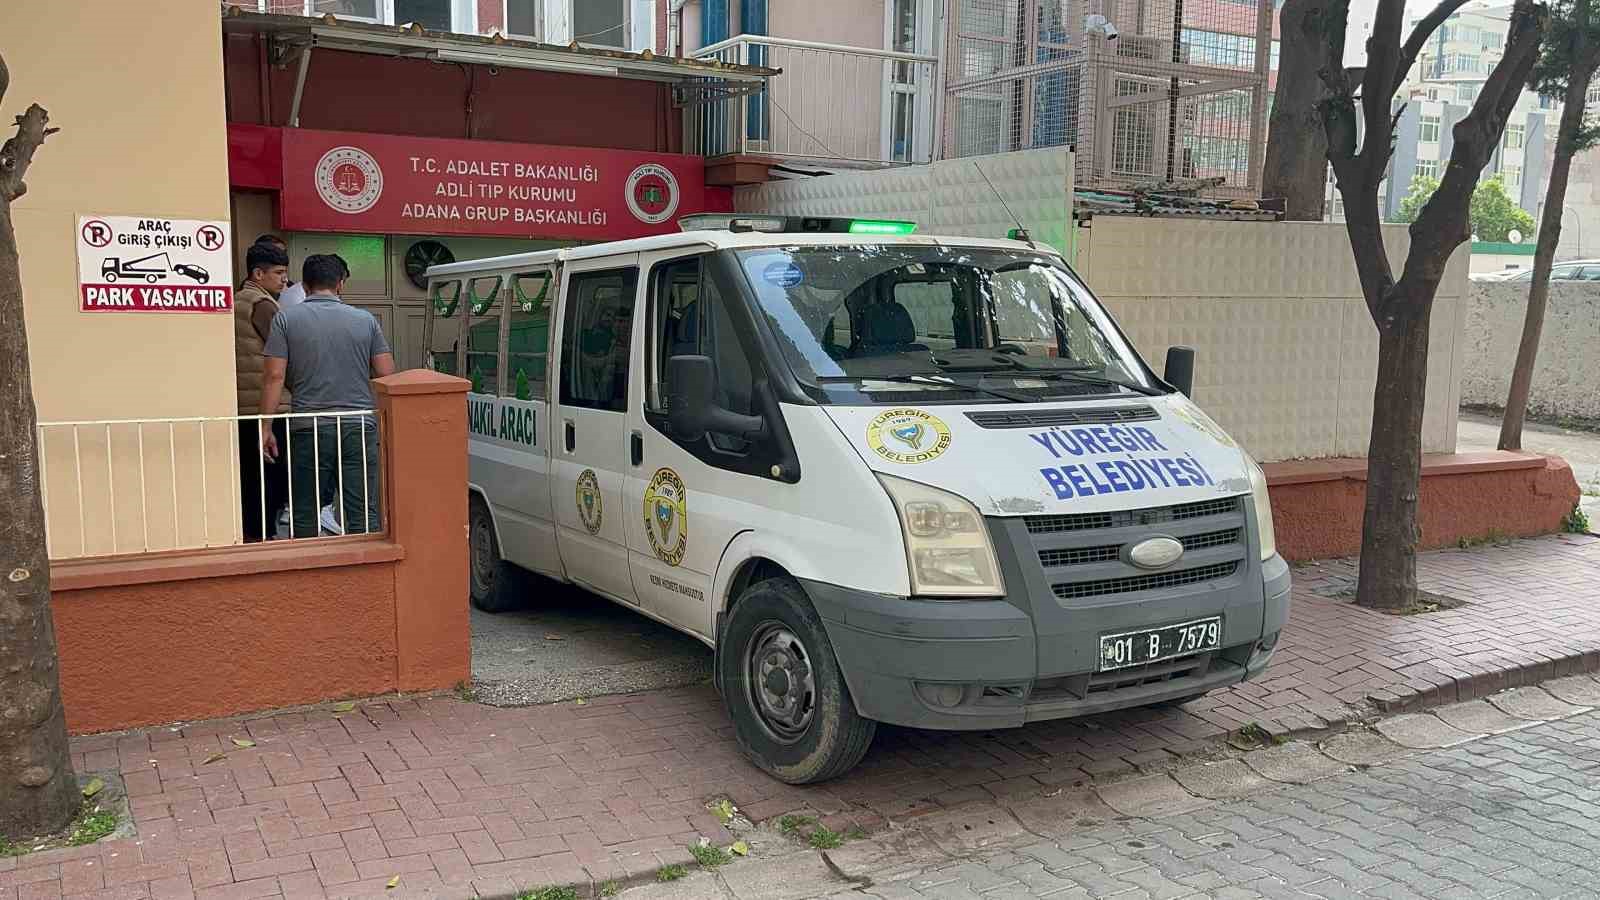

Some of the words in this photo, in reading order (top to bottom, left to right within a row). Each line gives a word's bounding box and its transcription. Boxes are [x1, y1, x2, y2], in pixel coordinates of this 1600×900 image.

[409, 157, 441, 174] T.C.
[446, 159, 510, 178] ADALET
[514, 163, 598, 182] BAKANLIĞI
[435, 180, 473, 198] ADLİ
[478, 183, 504, 199] TIP
[508, 185, 576, 202] KURUMU
[402, 203, 461, 219] ADANA
[465, 205, 510, 221] GRUP
[514, 207, 607, 225] BAŞKANLIĞI
[137, 220, 172, 235] ARAÇ
[154, 235, 192, 250] ÇIKIŞI
[86, 287, 135, 305] PARK
[139, 288, 226, 307] YASAKTIR
[500, 405, 537, 446] ARACI
[1029, 423, 1168, 458] YÜREĞİR
[1040, 451, 1215, 500] BELEDİYESİ
[1114, 637, 1133, 663] 01
[1148, 634, 1160, 658] B
[1177, 622, 1218, 652] 7579
